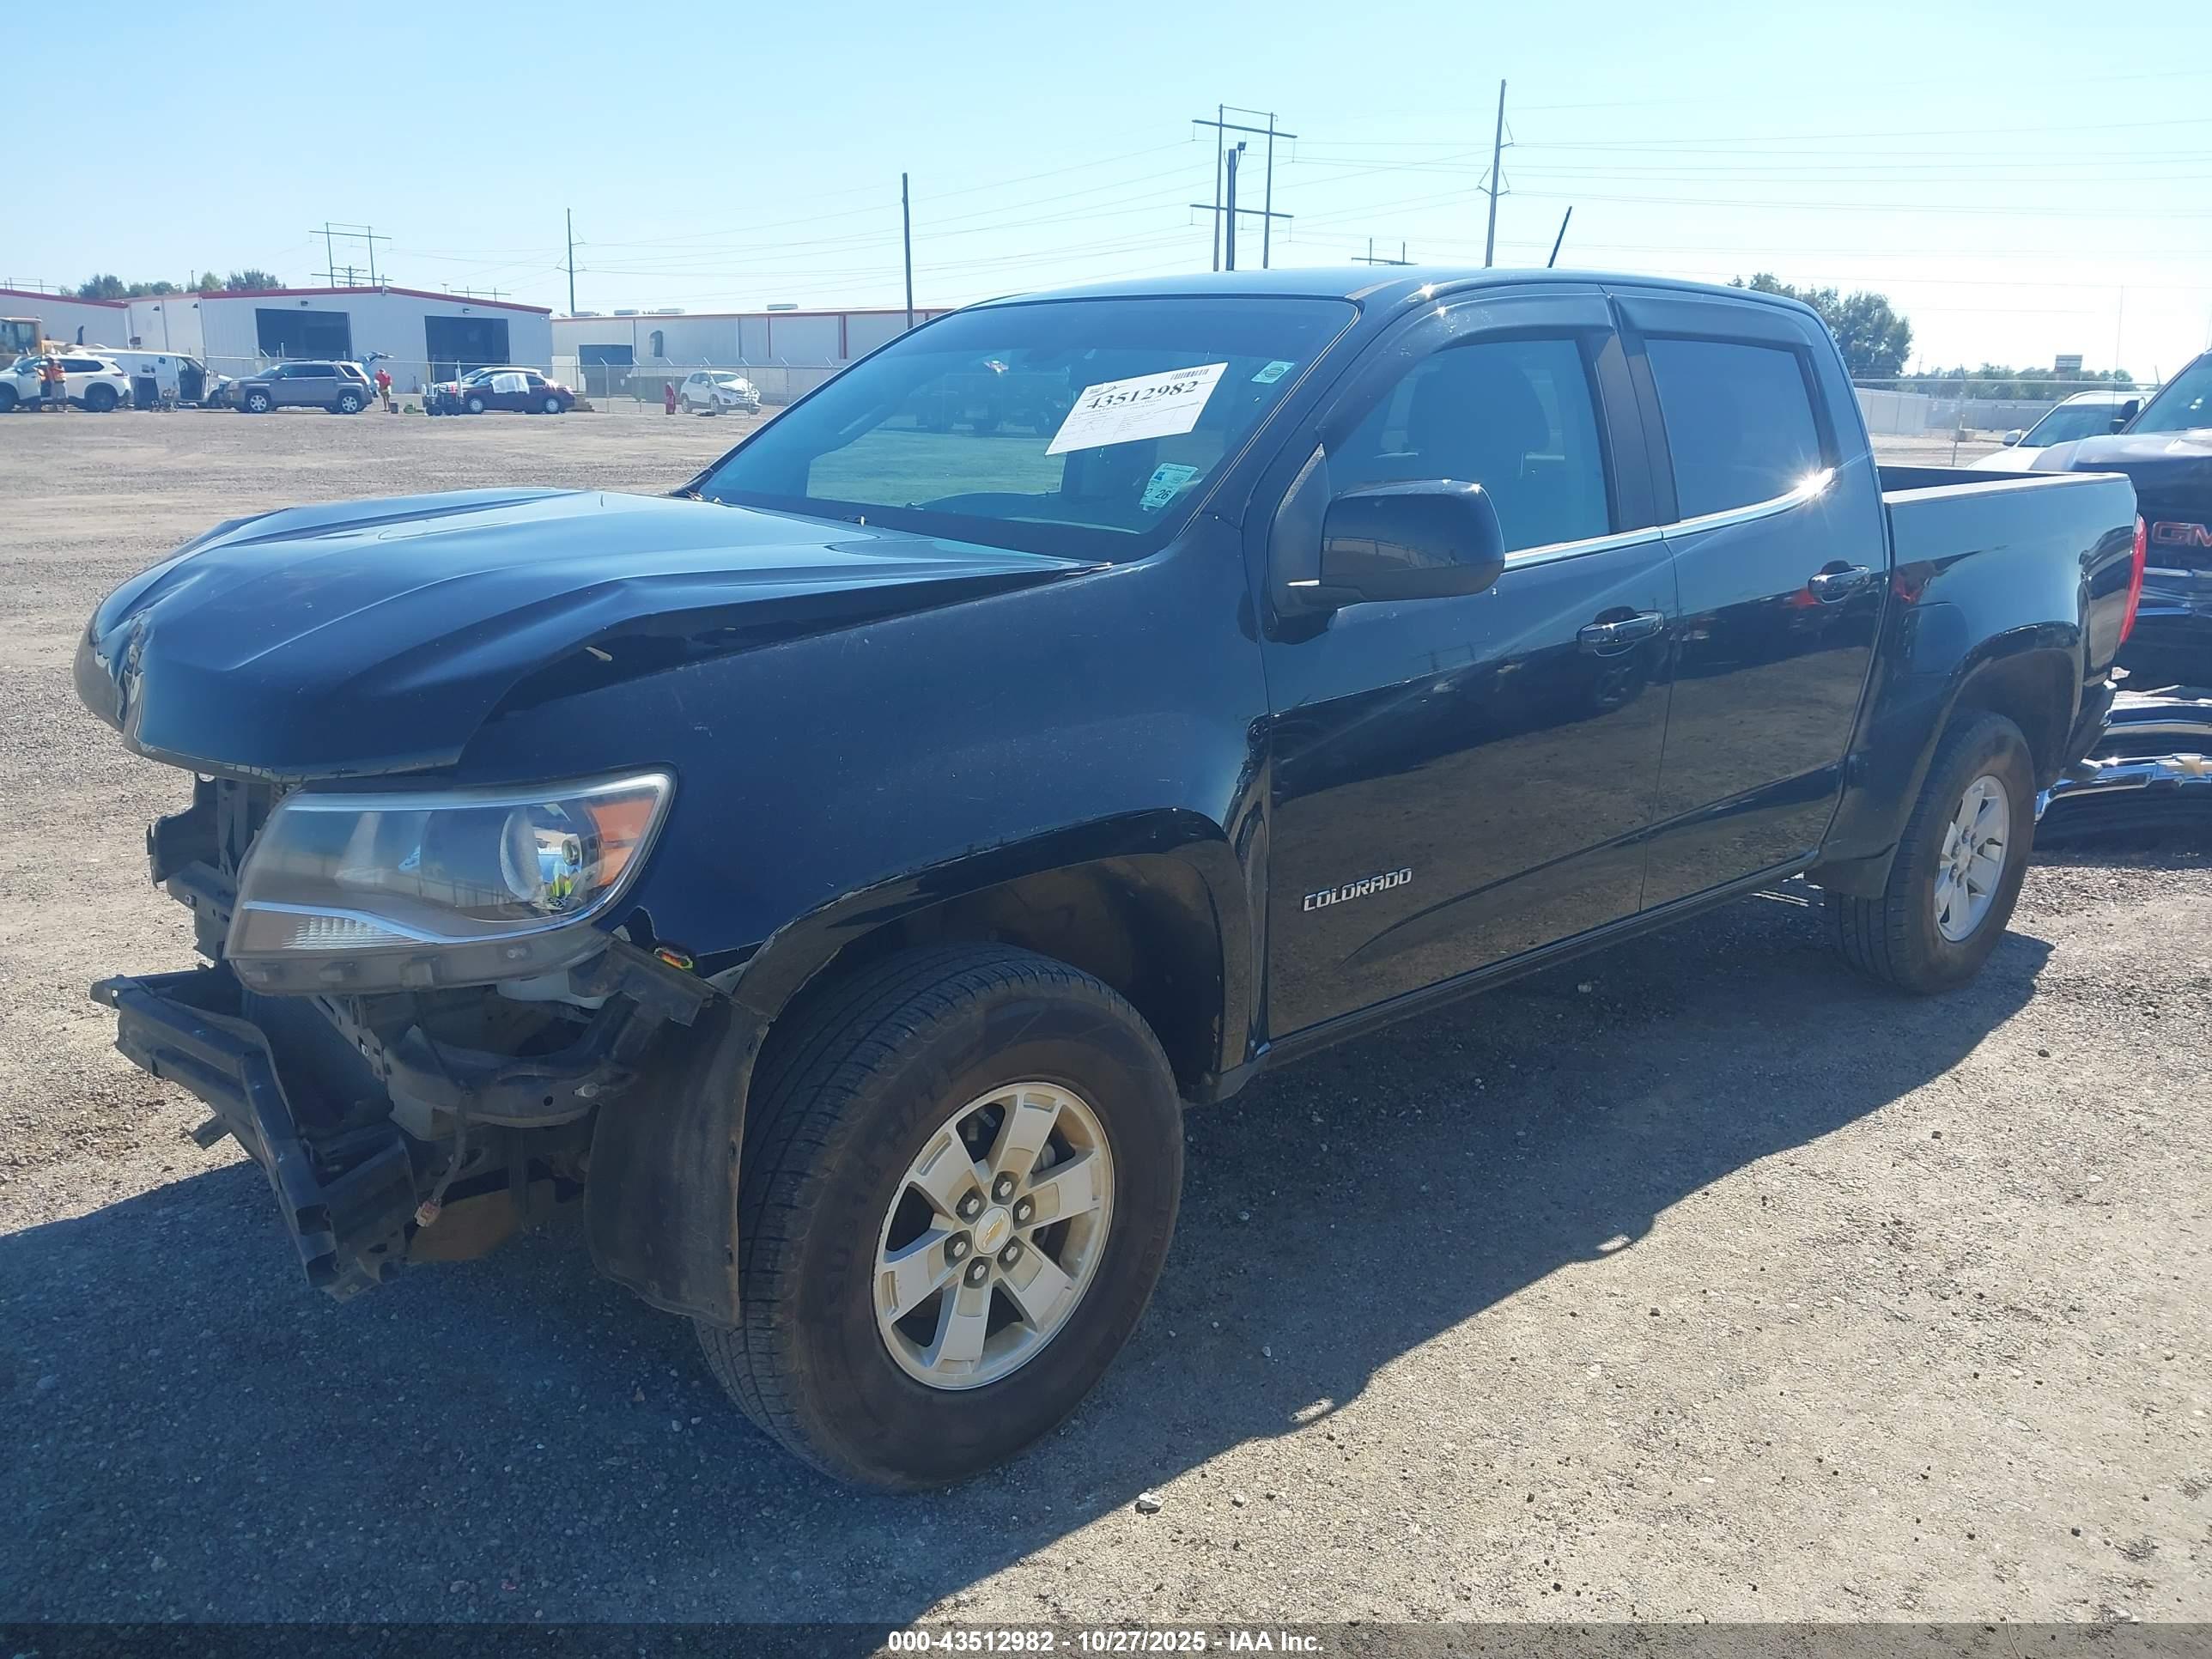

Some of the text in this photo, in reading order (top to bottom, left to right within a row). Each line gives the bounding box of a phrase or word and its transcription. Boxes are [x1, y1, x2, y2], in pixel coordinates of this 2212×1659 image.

[1086, 380, 1199, 410] 43512982
[1155, 489, 1171, 500] 26
[1303, 866, 1413, 912] COLORADO
